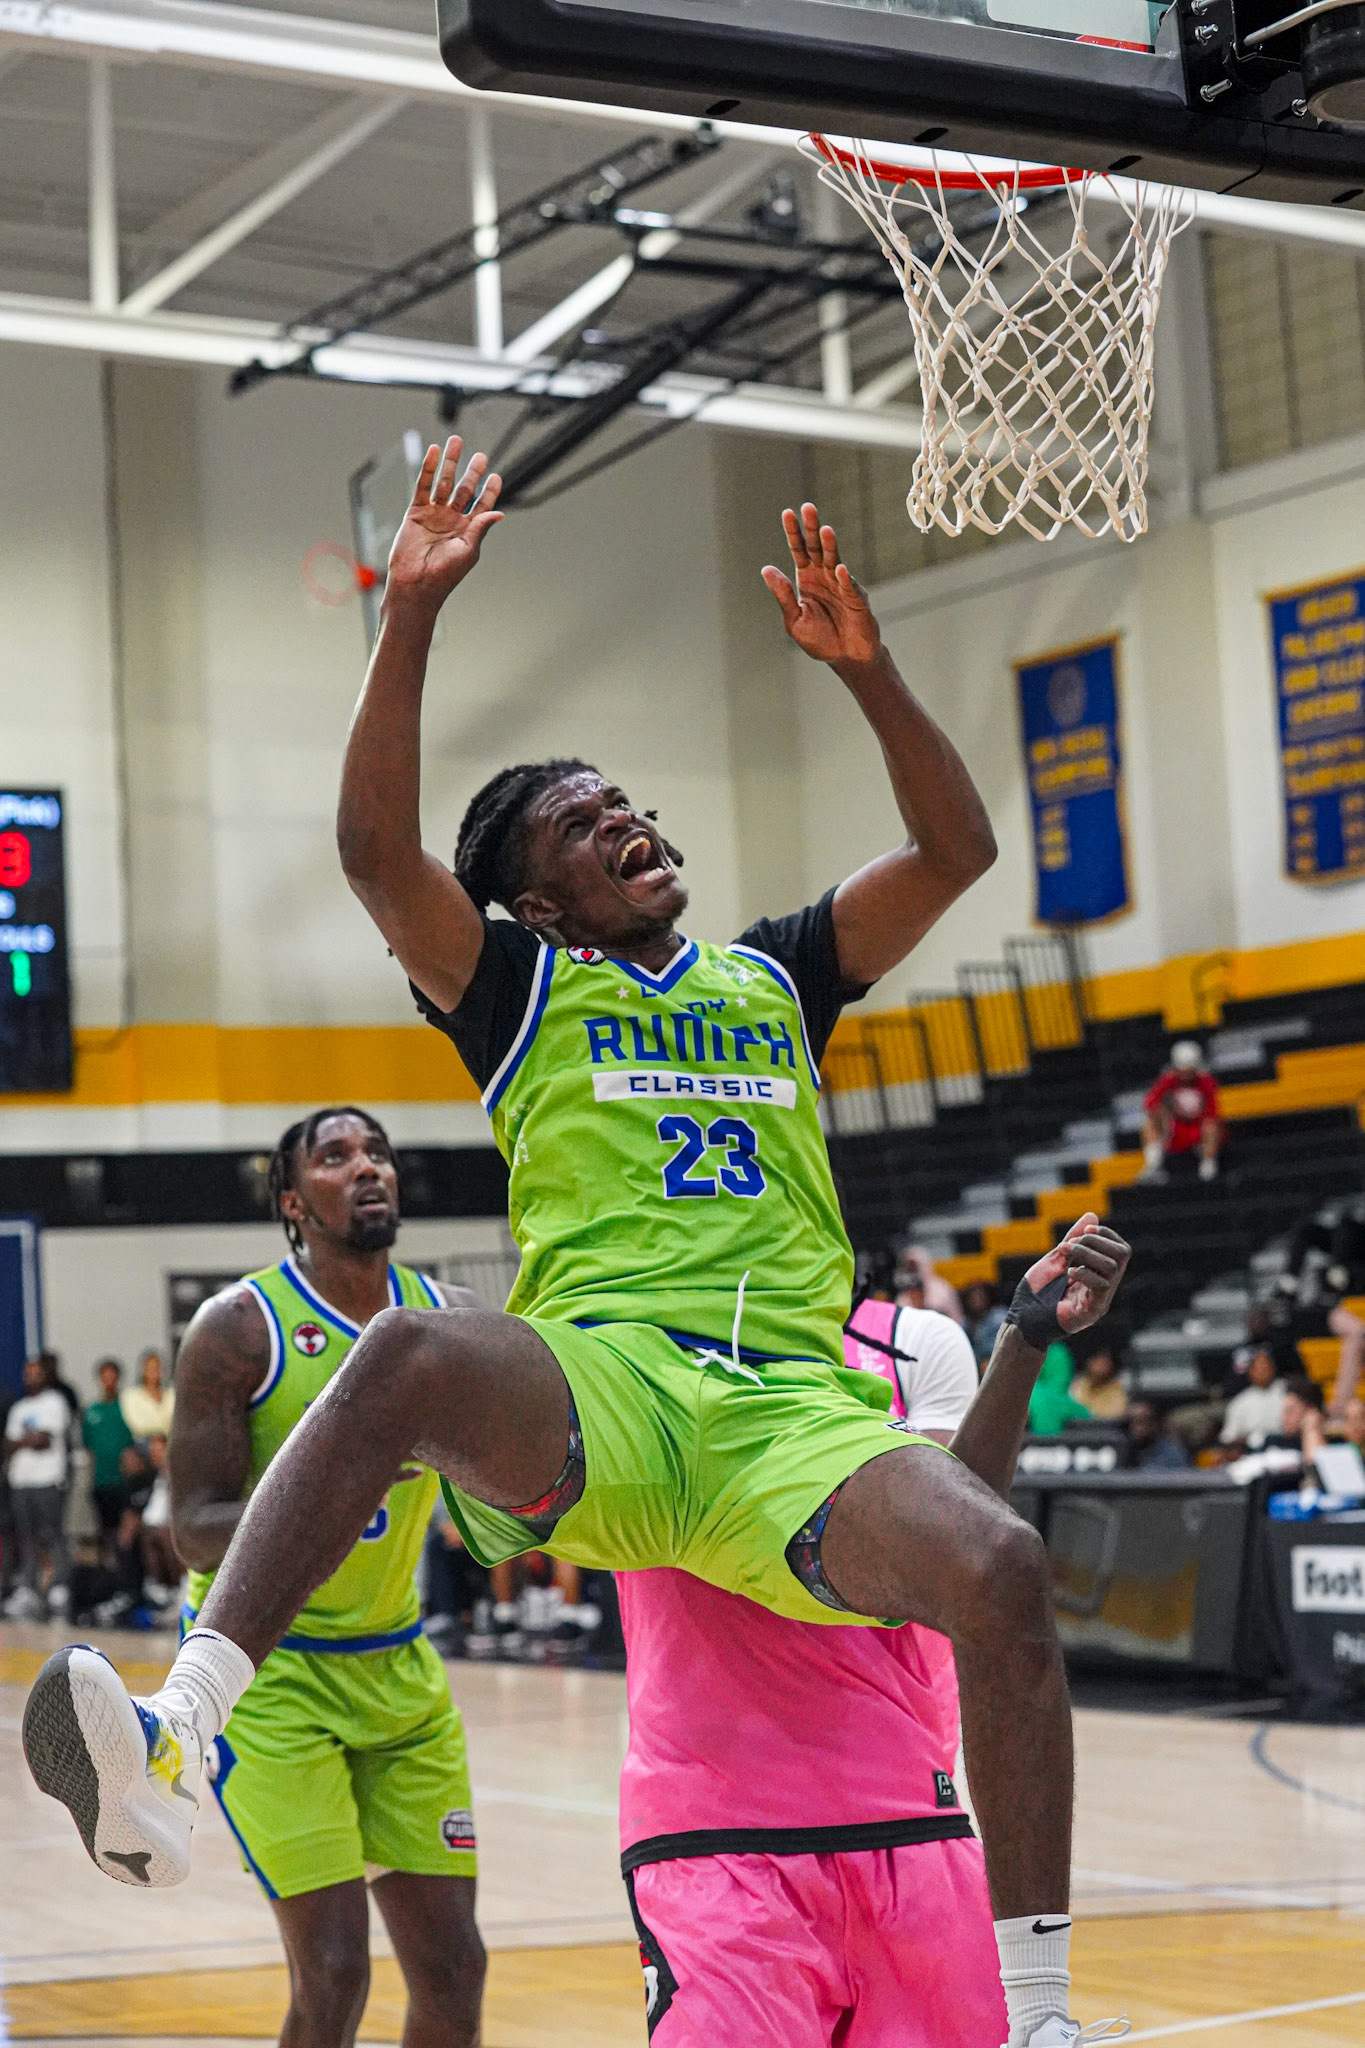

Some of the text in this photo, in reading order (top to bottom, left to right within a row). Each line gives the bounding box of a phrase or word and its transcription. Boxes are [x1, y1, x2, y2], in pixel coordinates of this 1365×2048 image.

[582, 1012, 797, 1069] RUMPH
[629, 1075, 773, 1098] CLASSIC
[655, 1113, 768, 1199] 23
